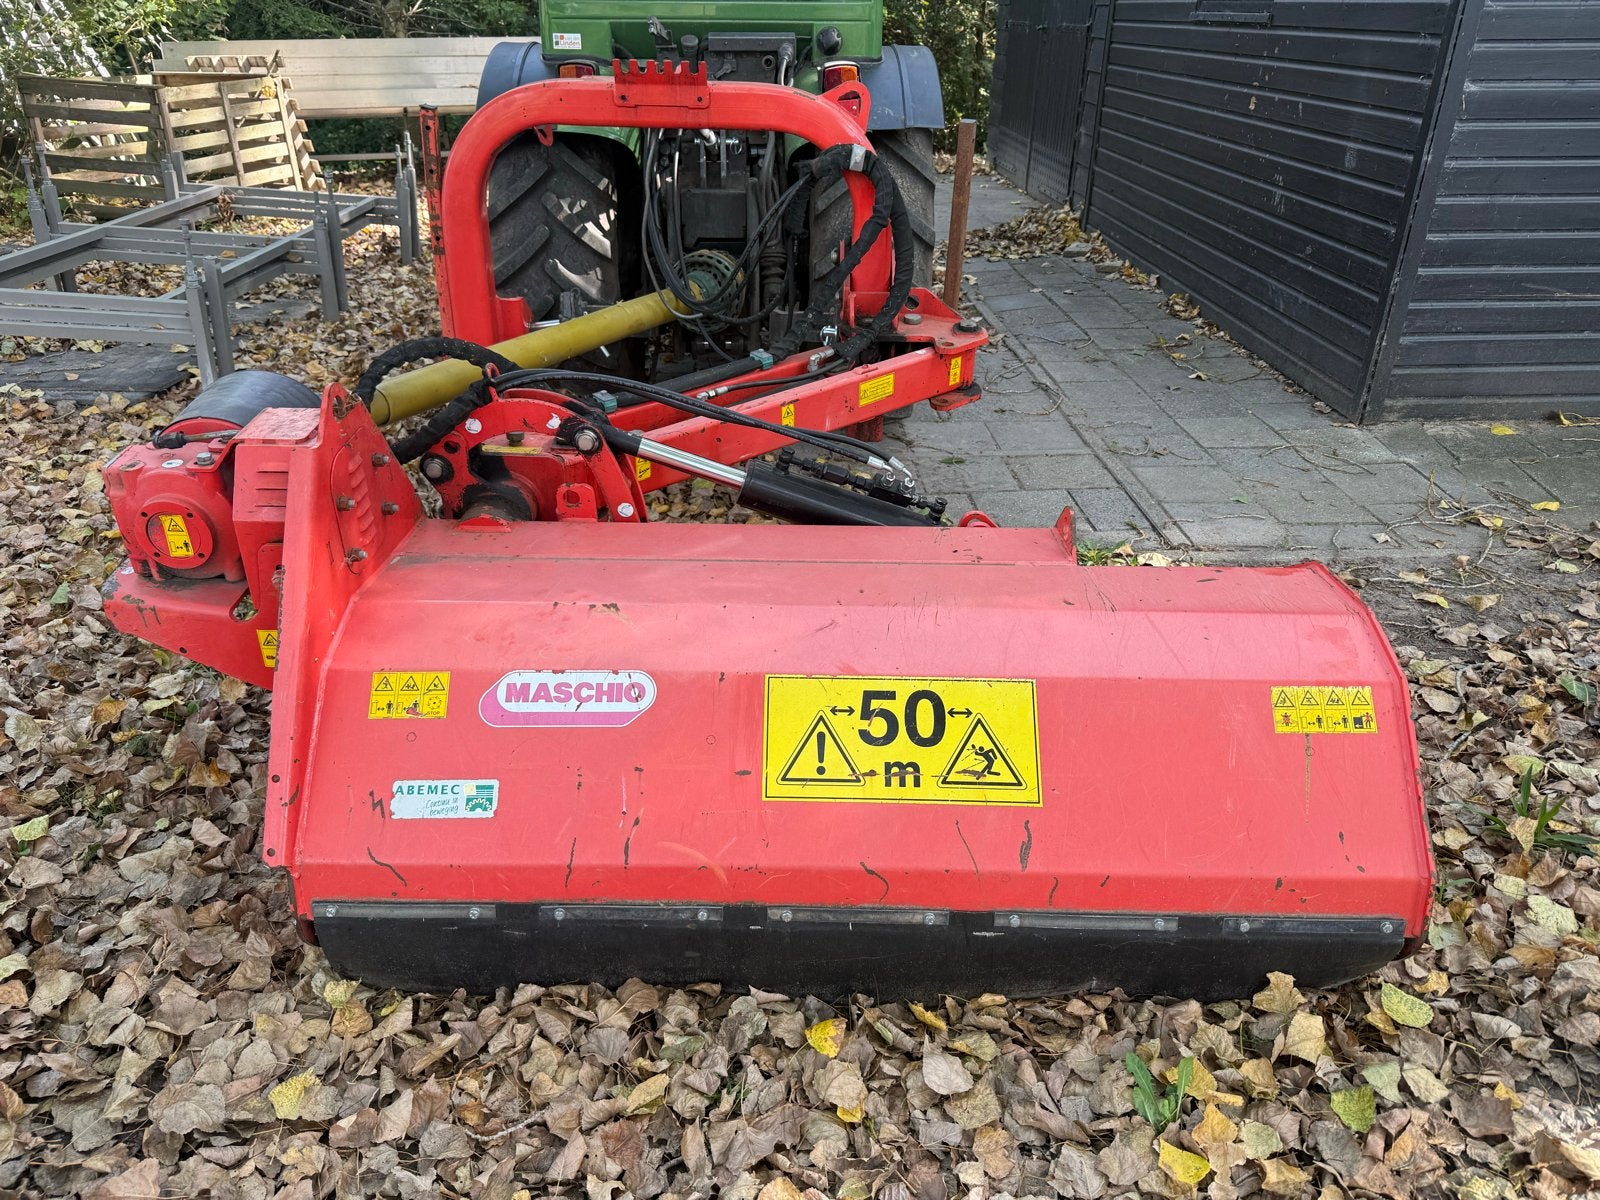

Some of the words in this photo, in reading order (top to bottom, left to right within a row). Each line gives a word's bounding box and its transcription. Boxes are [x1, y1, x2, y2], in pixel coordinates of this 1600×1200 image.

[505, 682, 646, 703] MASCHIO
[858, 689, 946, 747] 50
[885, 761, 920, 787] m
[395, 785, 460, 795] ABEMEC
